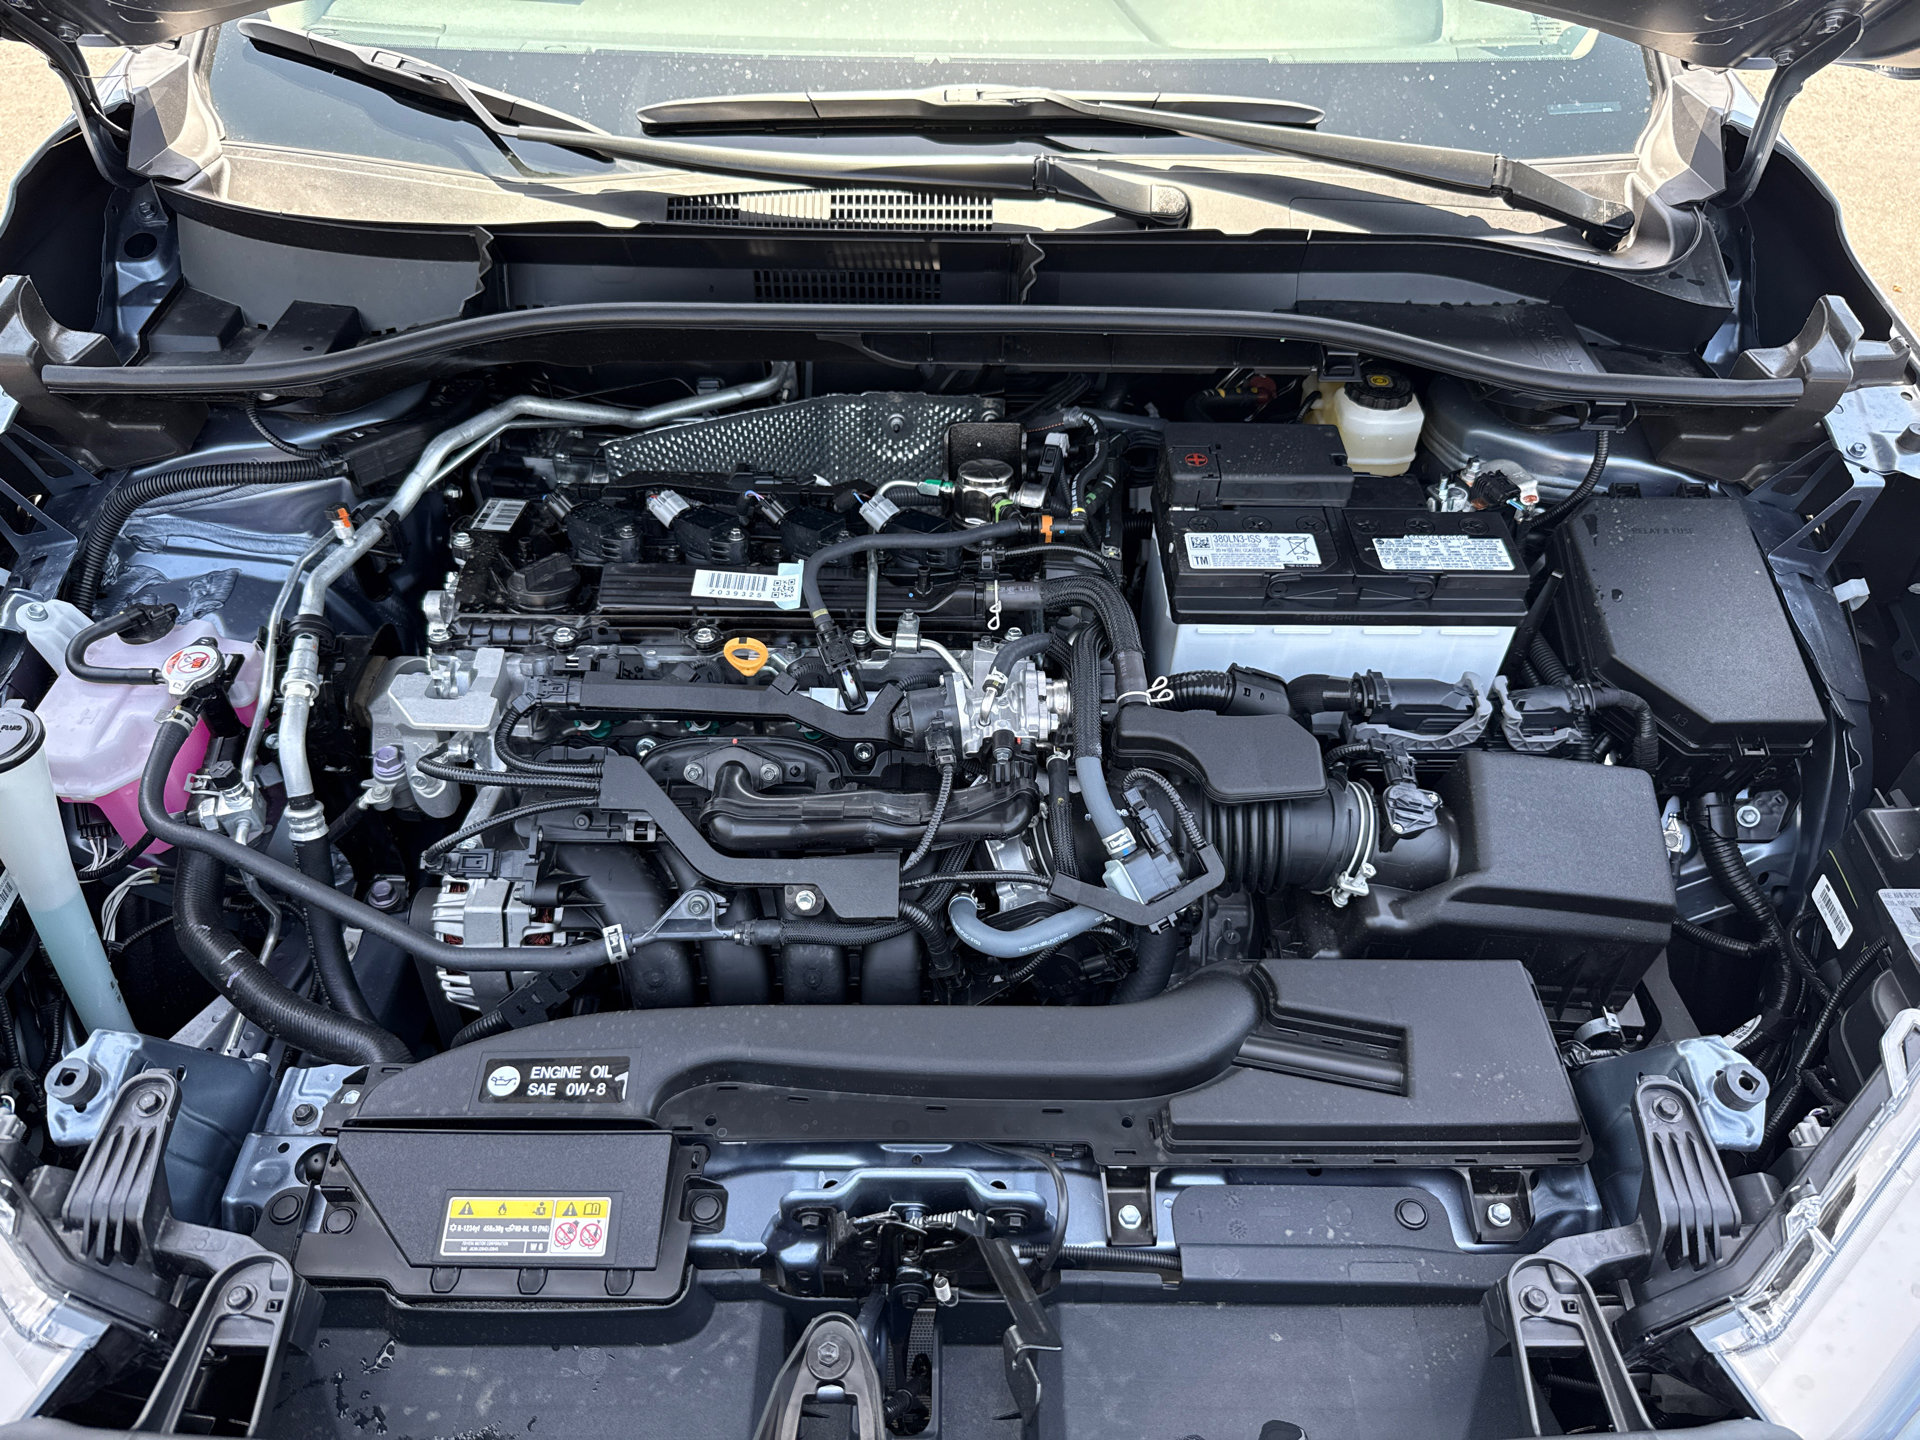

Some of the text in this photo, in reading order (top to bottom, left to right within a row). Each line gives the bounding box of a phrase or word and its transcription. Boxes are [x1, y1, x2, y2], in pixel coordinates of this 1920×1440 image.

[1212, 535, 1262, 544] 380LN3-ISS
[1194, 556, 1209, 565] TM
[709, 589, 762, 598] Z039325
[530, 1065, 613, 1079] ENGINE OIL
[527, 1083, 606, 1096] SAE 0W-8
